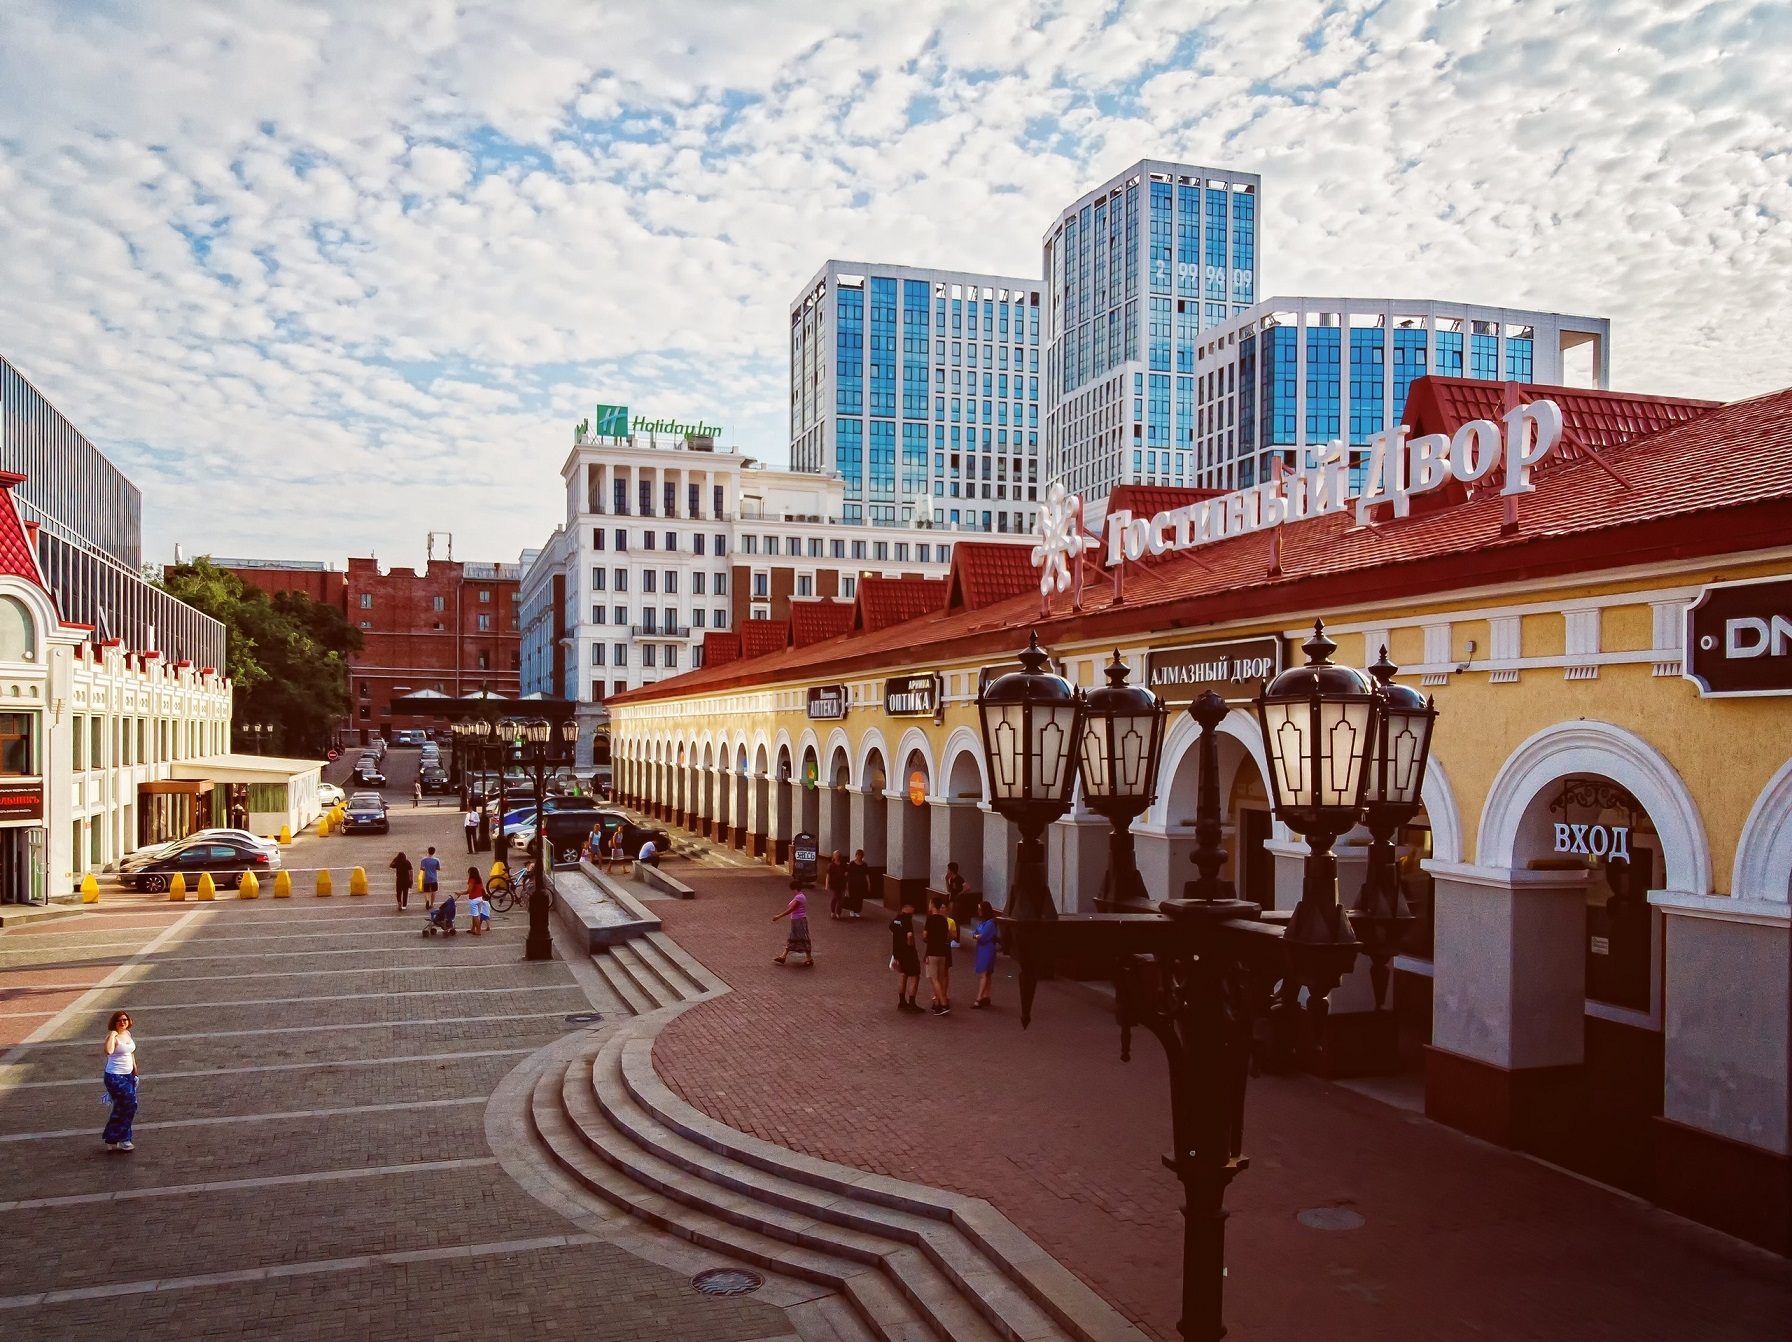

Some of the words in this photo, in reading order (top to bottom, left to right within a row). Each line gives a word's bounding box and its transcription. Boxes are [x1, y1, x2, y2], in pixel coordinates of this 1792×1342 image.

[1156, 260, 1166, 278] 2
[1179, 263, 1198, 282] 99
[1206, 265, 1225, 285] 96
[1233, 269, 1252, 288] 09
[632, 415, 695, 439] Holiday
[698, 420, 721, 437] Inn
[1105, 439, 1348, 566] Гостиный
[1355, 399, 1563, 526] Двор
[1151, 656, 1228, 686] АЛМАЗНЫЙ
[1231, 657, 1272, 685] ДВОР
[810, 699, 837, 717] АПТЕКА
[889, 691, 929, 712] ОПТИКА
[1553, 823, 1630, 864] ВХОД
